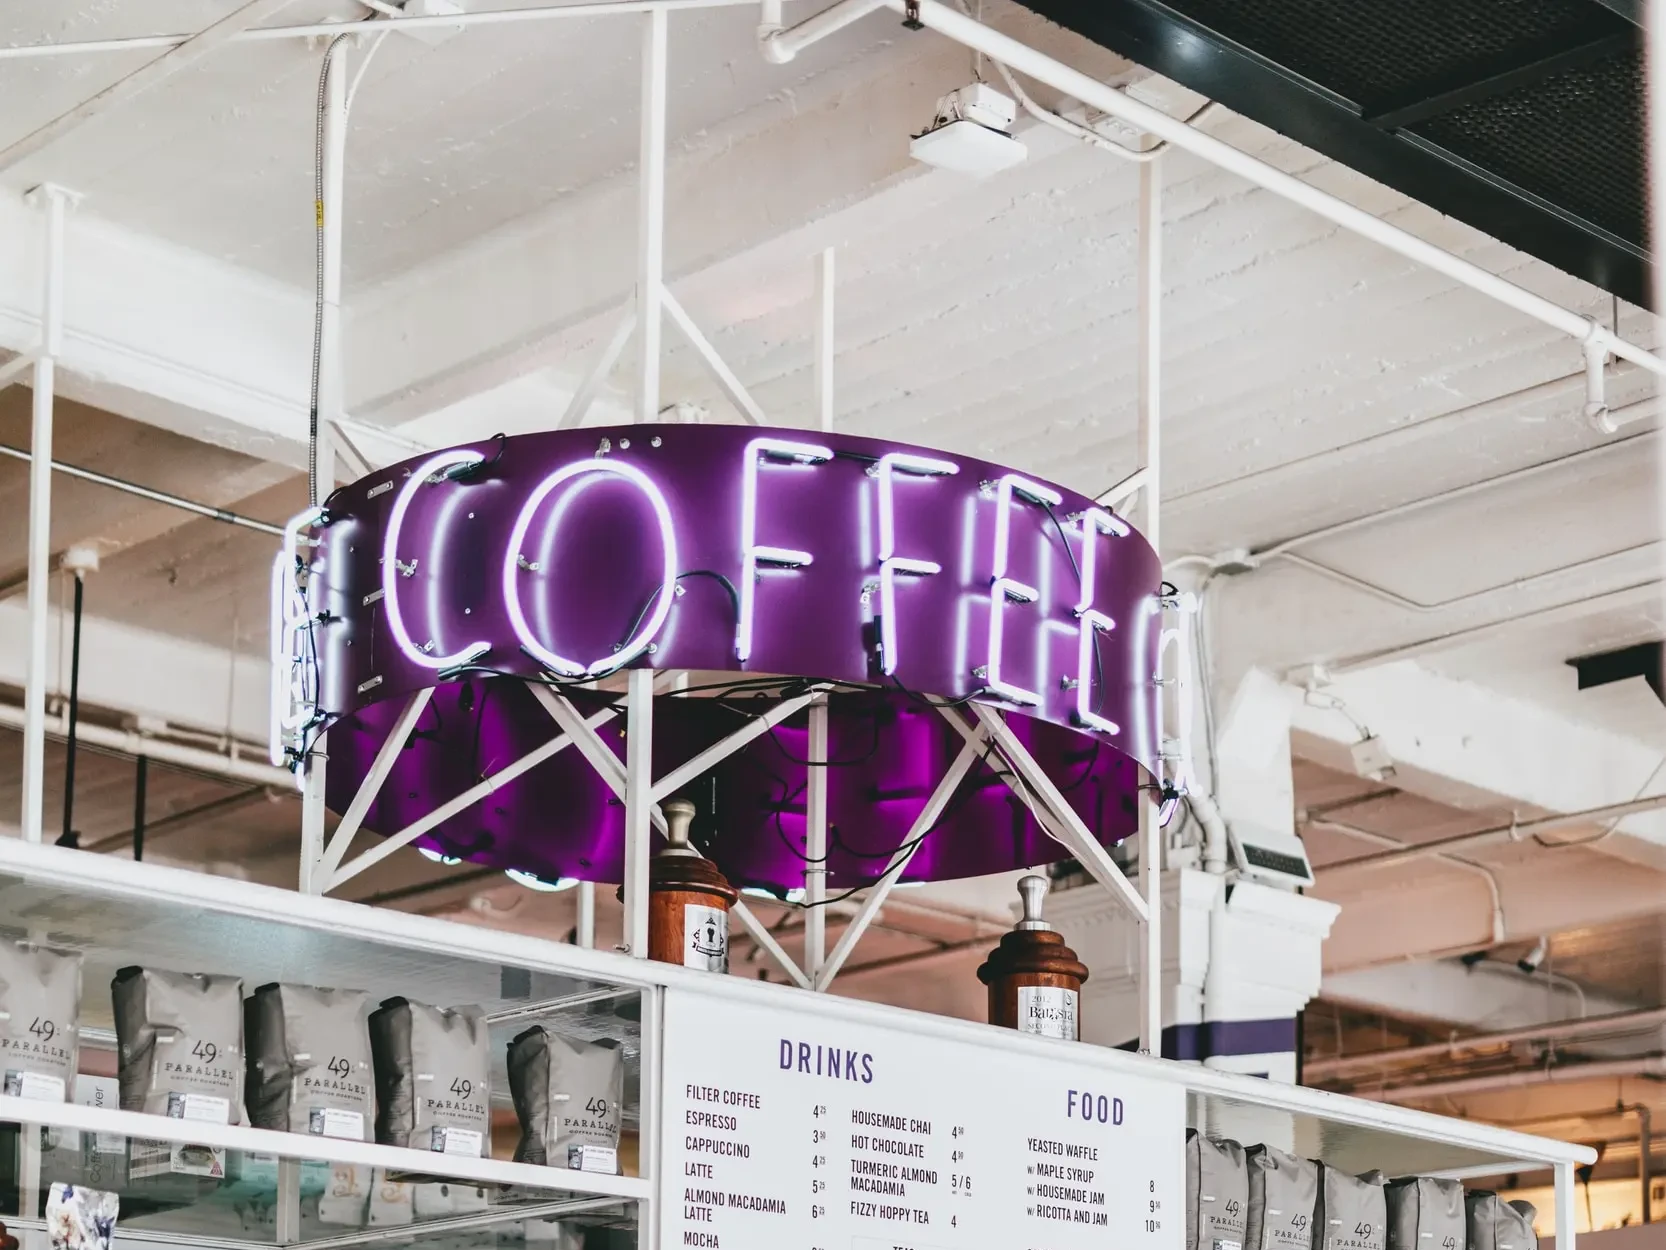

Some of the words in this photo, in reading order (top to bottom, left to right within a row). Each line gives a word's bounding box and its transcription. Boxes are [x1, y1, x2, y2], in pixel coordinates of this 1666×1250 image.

[383, 437, 1130, 736] COFFEE
[29, 1016, 55, 1042] 49
[2, 1038, 70, 1060] PARALLEL
[192, 1039, 217, 1064] 49
[779, 1038, 873, 1083] DRINKS
[164, 1062, 234, 1080] PARALLEL
[327, 1056, 350, 1079] 49
[304, 1078, 366, 1095] PARALLEL
[450, 1077, 471, 1100] 49
[427, 1099, 485, 1115] PARALLEL
[585, 1097, 607, 1118] 49
[686, 1084, 720, 1103] FILTER
[723, 1090, 760, 1109] COFFEE
[813, 1105, 819, 1118] 4
[1067, 1089, 1123, 1125] FOOD
[686, 1110, 737, 1131] ESPRESSO
[813, 1130, 818, 1143] 3
[852, 1109, 907, 1131] HOUSEMADE
[910, 1119, 931, 1135] CHAI
[952, 1126, 957, 1139] 4
[685, 1136, 750, 1158] CAPPUCCINO
[812, 1155, 818, 1168] 4
[851, 1134, 869, 1150] HOT
[872, 1138, 924, 1158] CHOCOLATE
[952, 1150, 957, 1163] 4
[1027, 1138, 1063, 1156] YEASTED
[1066, 1144, 1098, 1161] WAFFLE
[685, 1162, 713, 1179] LATTE
[812, 1180, 818, 1193] 5
[851, 1159, 898, 1179] TURMERIC
[901, 1167, 937, 1185] ALMOND
[952, 1175, 957, 1187] 5
[966, 1176, 971, 1189] 6
[851, 1176, 905, 1197] MACADAMIA
[1037, 1163, 1064, 1179] MAPLE
[1067, 1167, 1094, 1183] SYRUP
[1150, 1180, 1154, 1193] 8
[684, 1188, 725, 1206] ALMOND
[728, 1193, 786, 1214] MACADAMIA
[812, 1205, 817, 1218] 6
[1037, 1183, 1087, 1203] HOUSEMADE
[1089, 1192, 1105, 1205] JAM
[1150, 1200, 1154, 1213] 9
[1225, 1199, 1239, 1218] 49
[684, 1205, 713, 1222] LATTE
[851, 1201, 877, 1217] FIZZY
[880, 1205, 911, 1222] HOPPY
[913, 1209, 929, 1224] TEA
[951, 1215, 957, 1228] 4
[1037, 1204, 1071, 1221] RICOTTA
[1074, 1209, 1090, 1224] AND
[1093, 1213, 1108, 1226] JAM
[1145, 1220, 1155, 1233] 10
[1291, 1213, 1307, 1232] 49
[684, 1231, 719, 1249] MOCHA
[1354, 1221, 1372, 1240] 49
